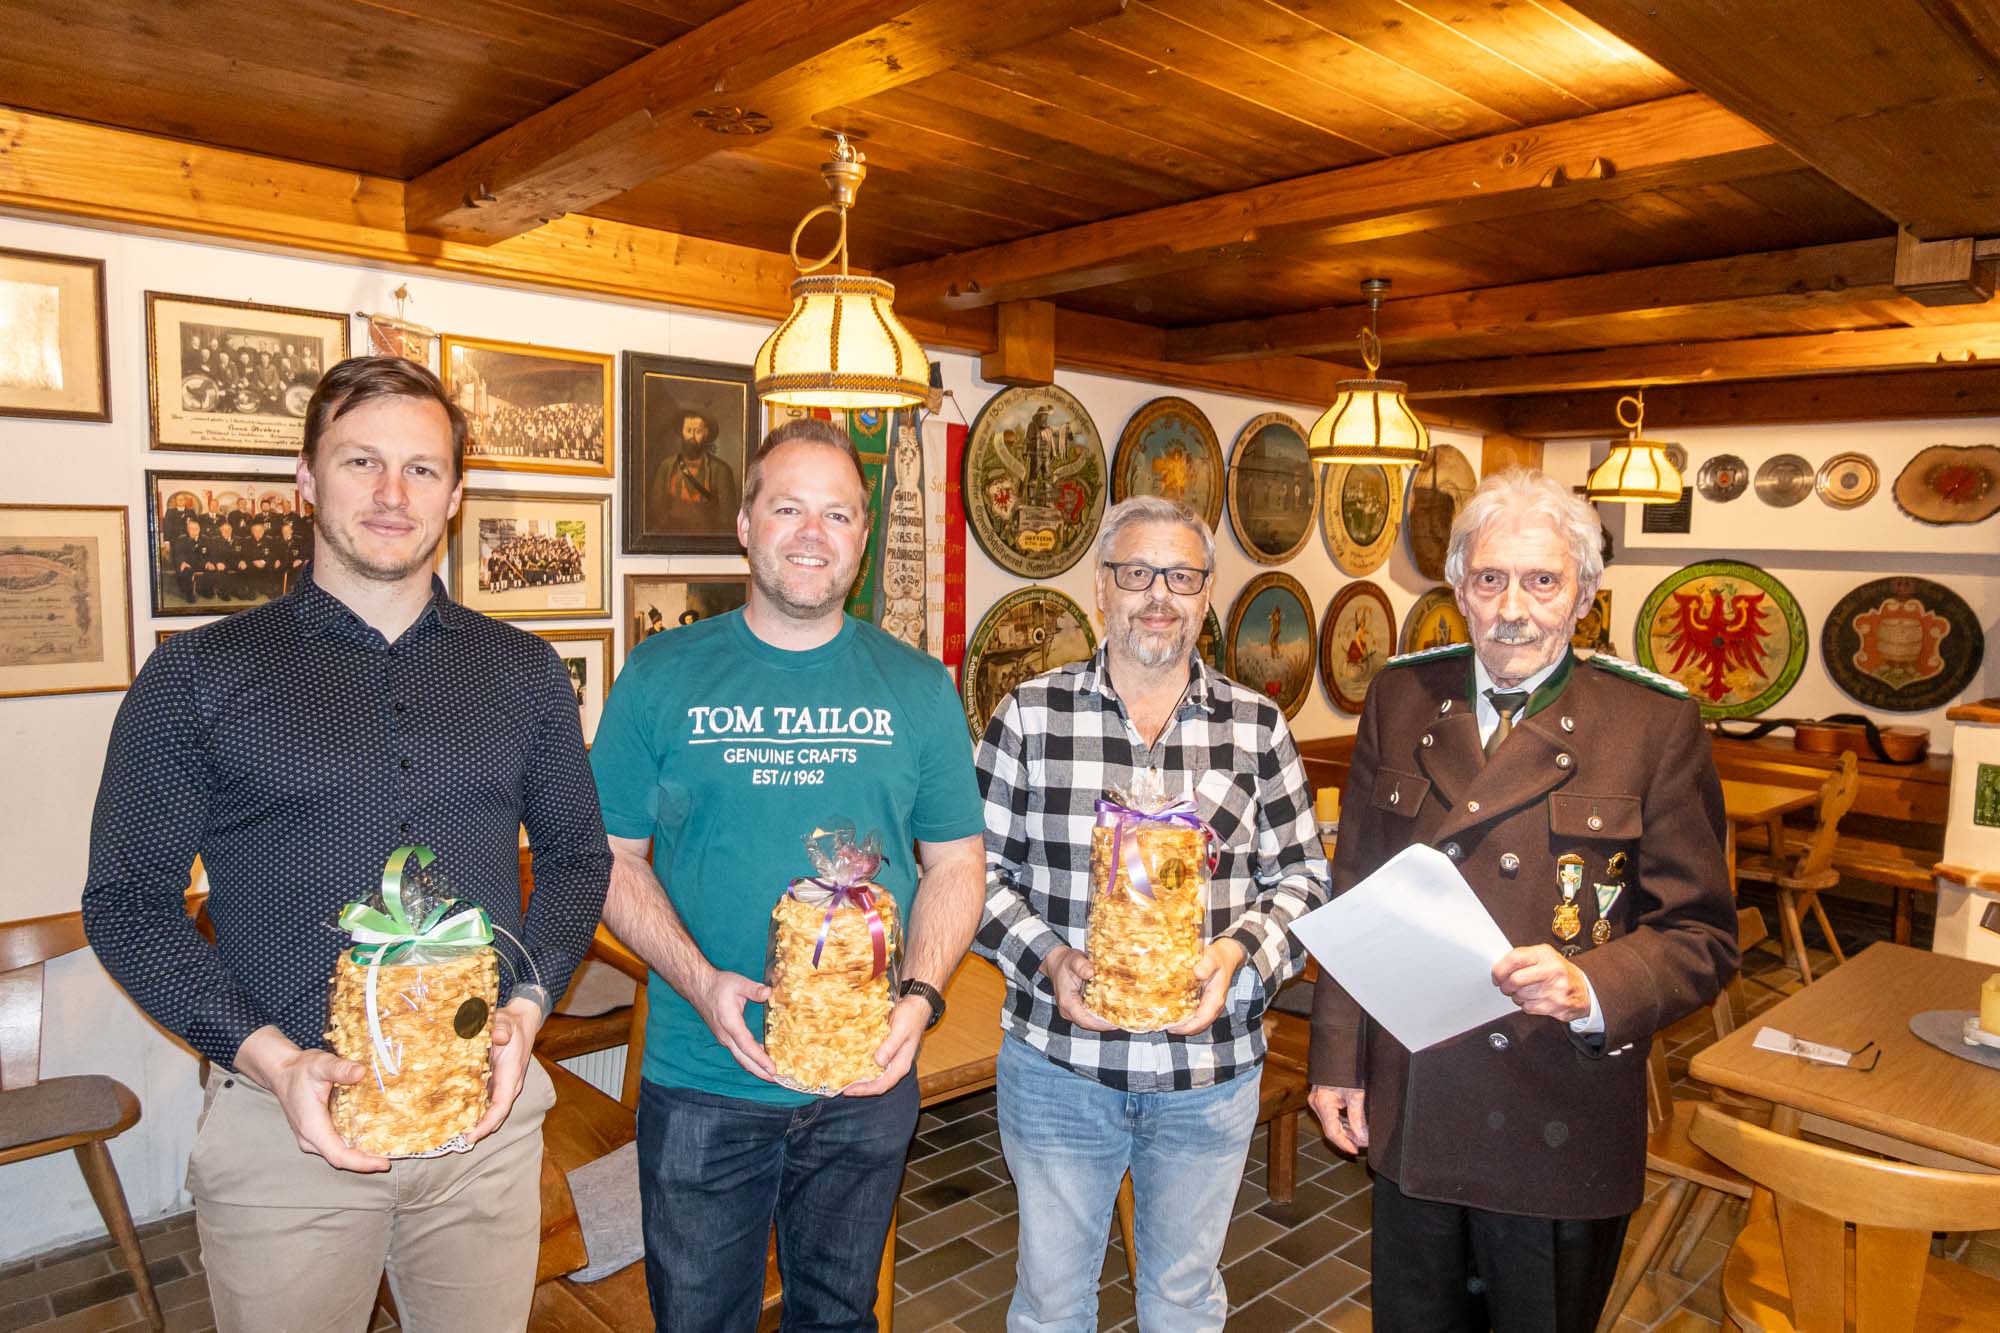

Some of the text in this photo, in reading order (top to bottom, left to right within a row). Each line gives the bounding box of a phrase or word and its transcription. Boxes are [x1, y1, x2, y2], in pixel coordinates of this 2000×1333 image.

[688, 706, 894, 736] TOM TAILOR
[723, 748, 857, 765] GENUINE CRAFTS
[752, 769, 779, 785] EST
[793, 769, 824, 785] 1962
